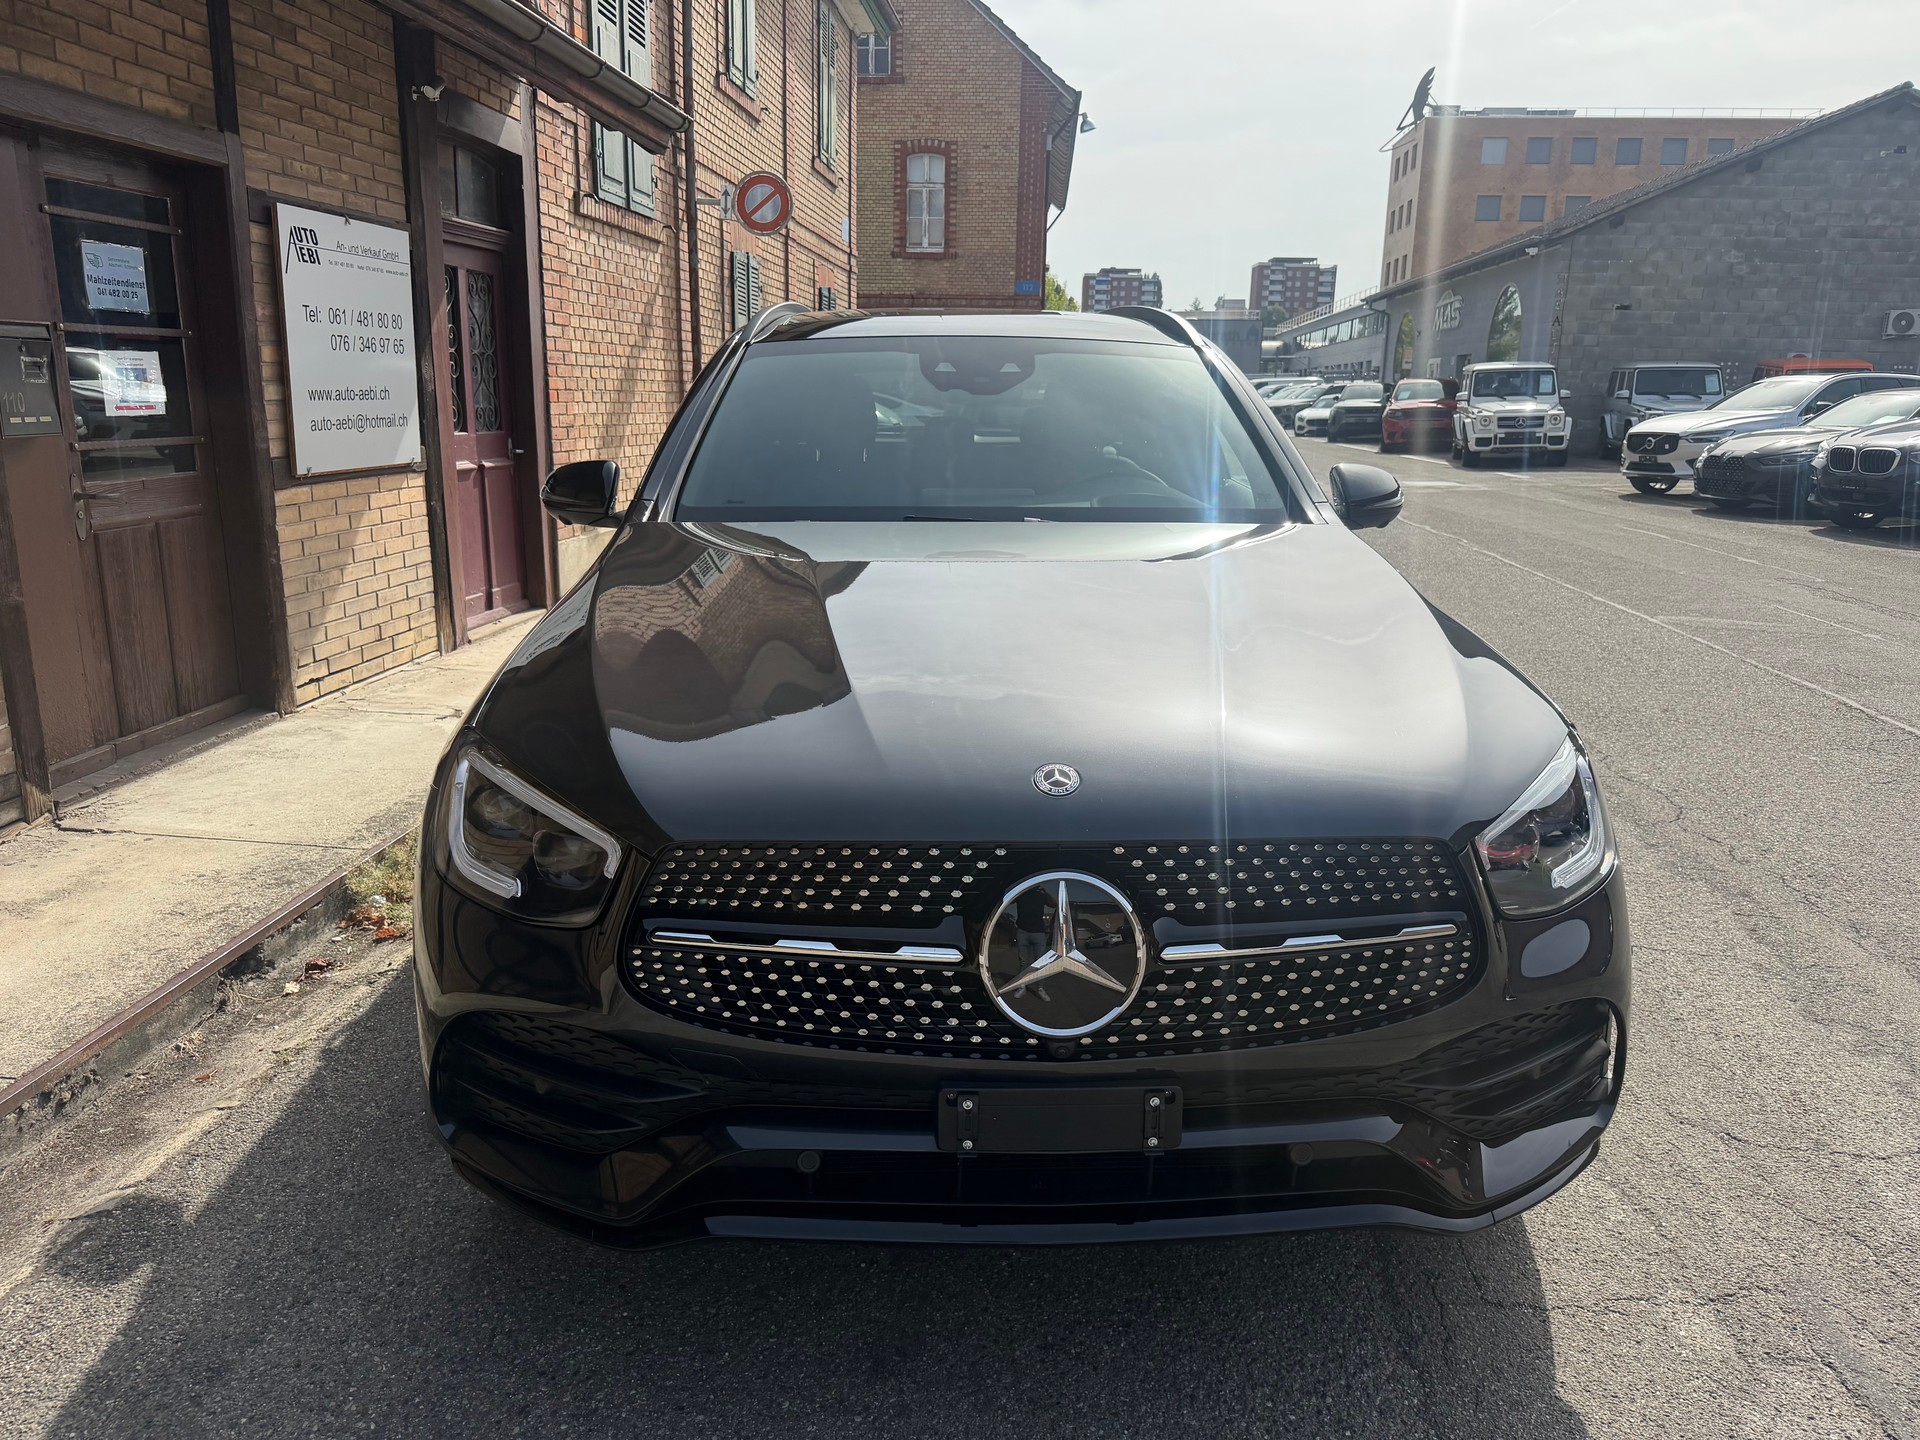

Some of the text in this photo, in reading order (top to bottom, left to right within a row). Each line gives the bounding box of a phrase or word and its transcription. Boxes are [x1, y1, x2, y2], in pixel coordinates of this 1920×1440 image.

[336, 240, 400, 262] An- und Verkauf GmbH
[86, 274, 146, 290] Mahlzeitendienst
[97, 287, 138, 300] 061 482 00 25
[302, 304, 403, 330] Tel: 061 / 481 80 80
[330, 334, 405, 354] 076 / 346 97 65
[3, 392, 26, 412] 110
[308, 386, 390, 401] www.auto-aebi.ch
[310, 413, 408, 433] auto-aebi@hotmail.ch
